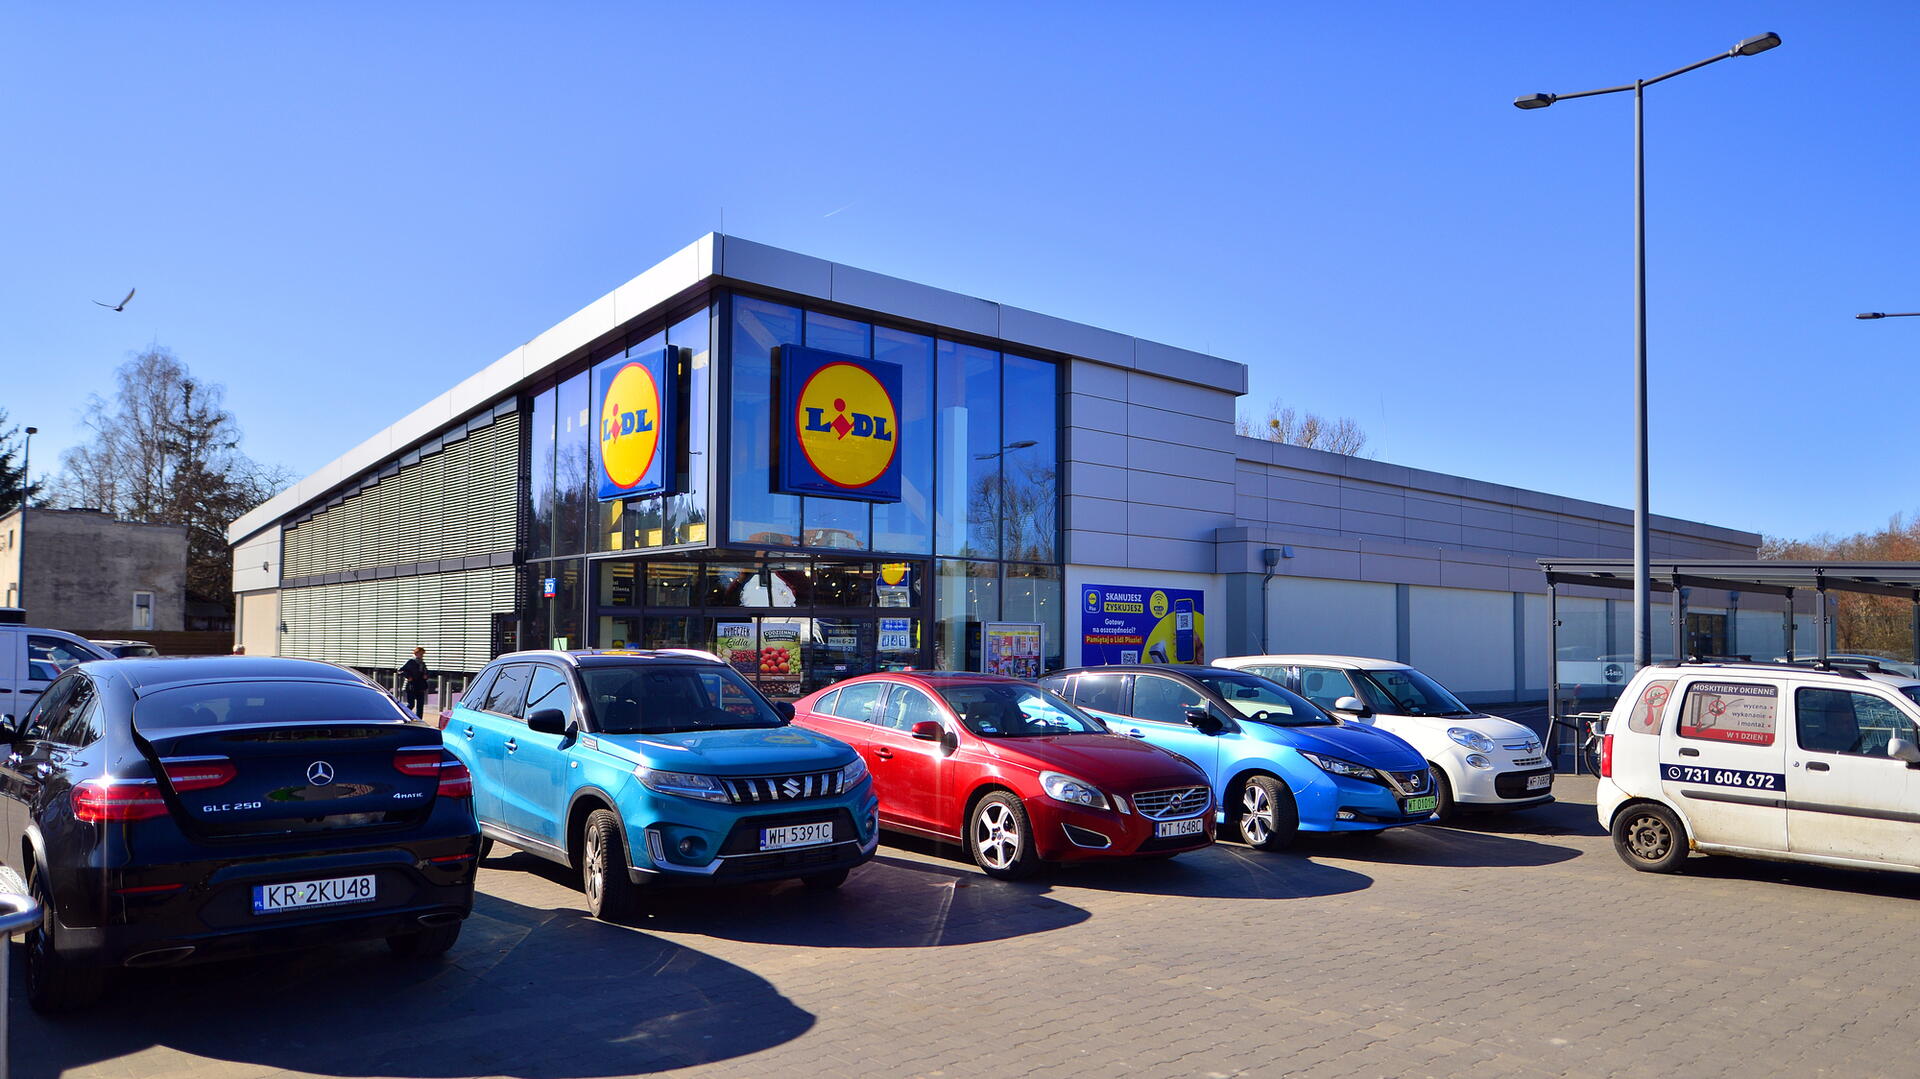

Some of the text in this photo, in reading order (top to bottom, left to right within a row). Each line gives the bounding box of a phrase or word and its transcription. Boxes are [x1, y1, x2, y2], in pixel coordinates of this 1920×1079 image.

[602, 403, 653, 444] LIDL
[805, 398, 892, 442] LIDL
[1105, 592, 1142, 602] SKANUJESZ
[1105, 603, 1142, 612] ZYSKUJESZ
[1104, 618, 1125, 627] Gotowy
[1693, 684, 1775, 695] MOSKITIERY OKIENNE
[1684, 767, 1775, 789] 731 606 672
[203, 801, 262, 813] GLC 250
[769, 824, 830, 845] WH 5391C
[268, 885, 297, 907] KR
[305, 878, 371, 904] 2KU48
